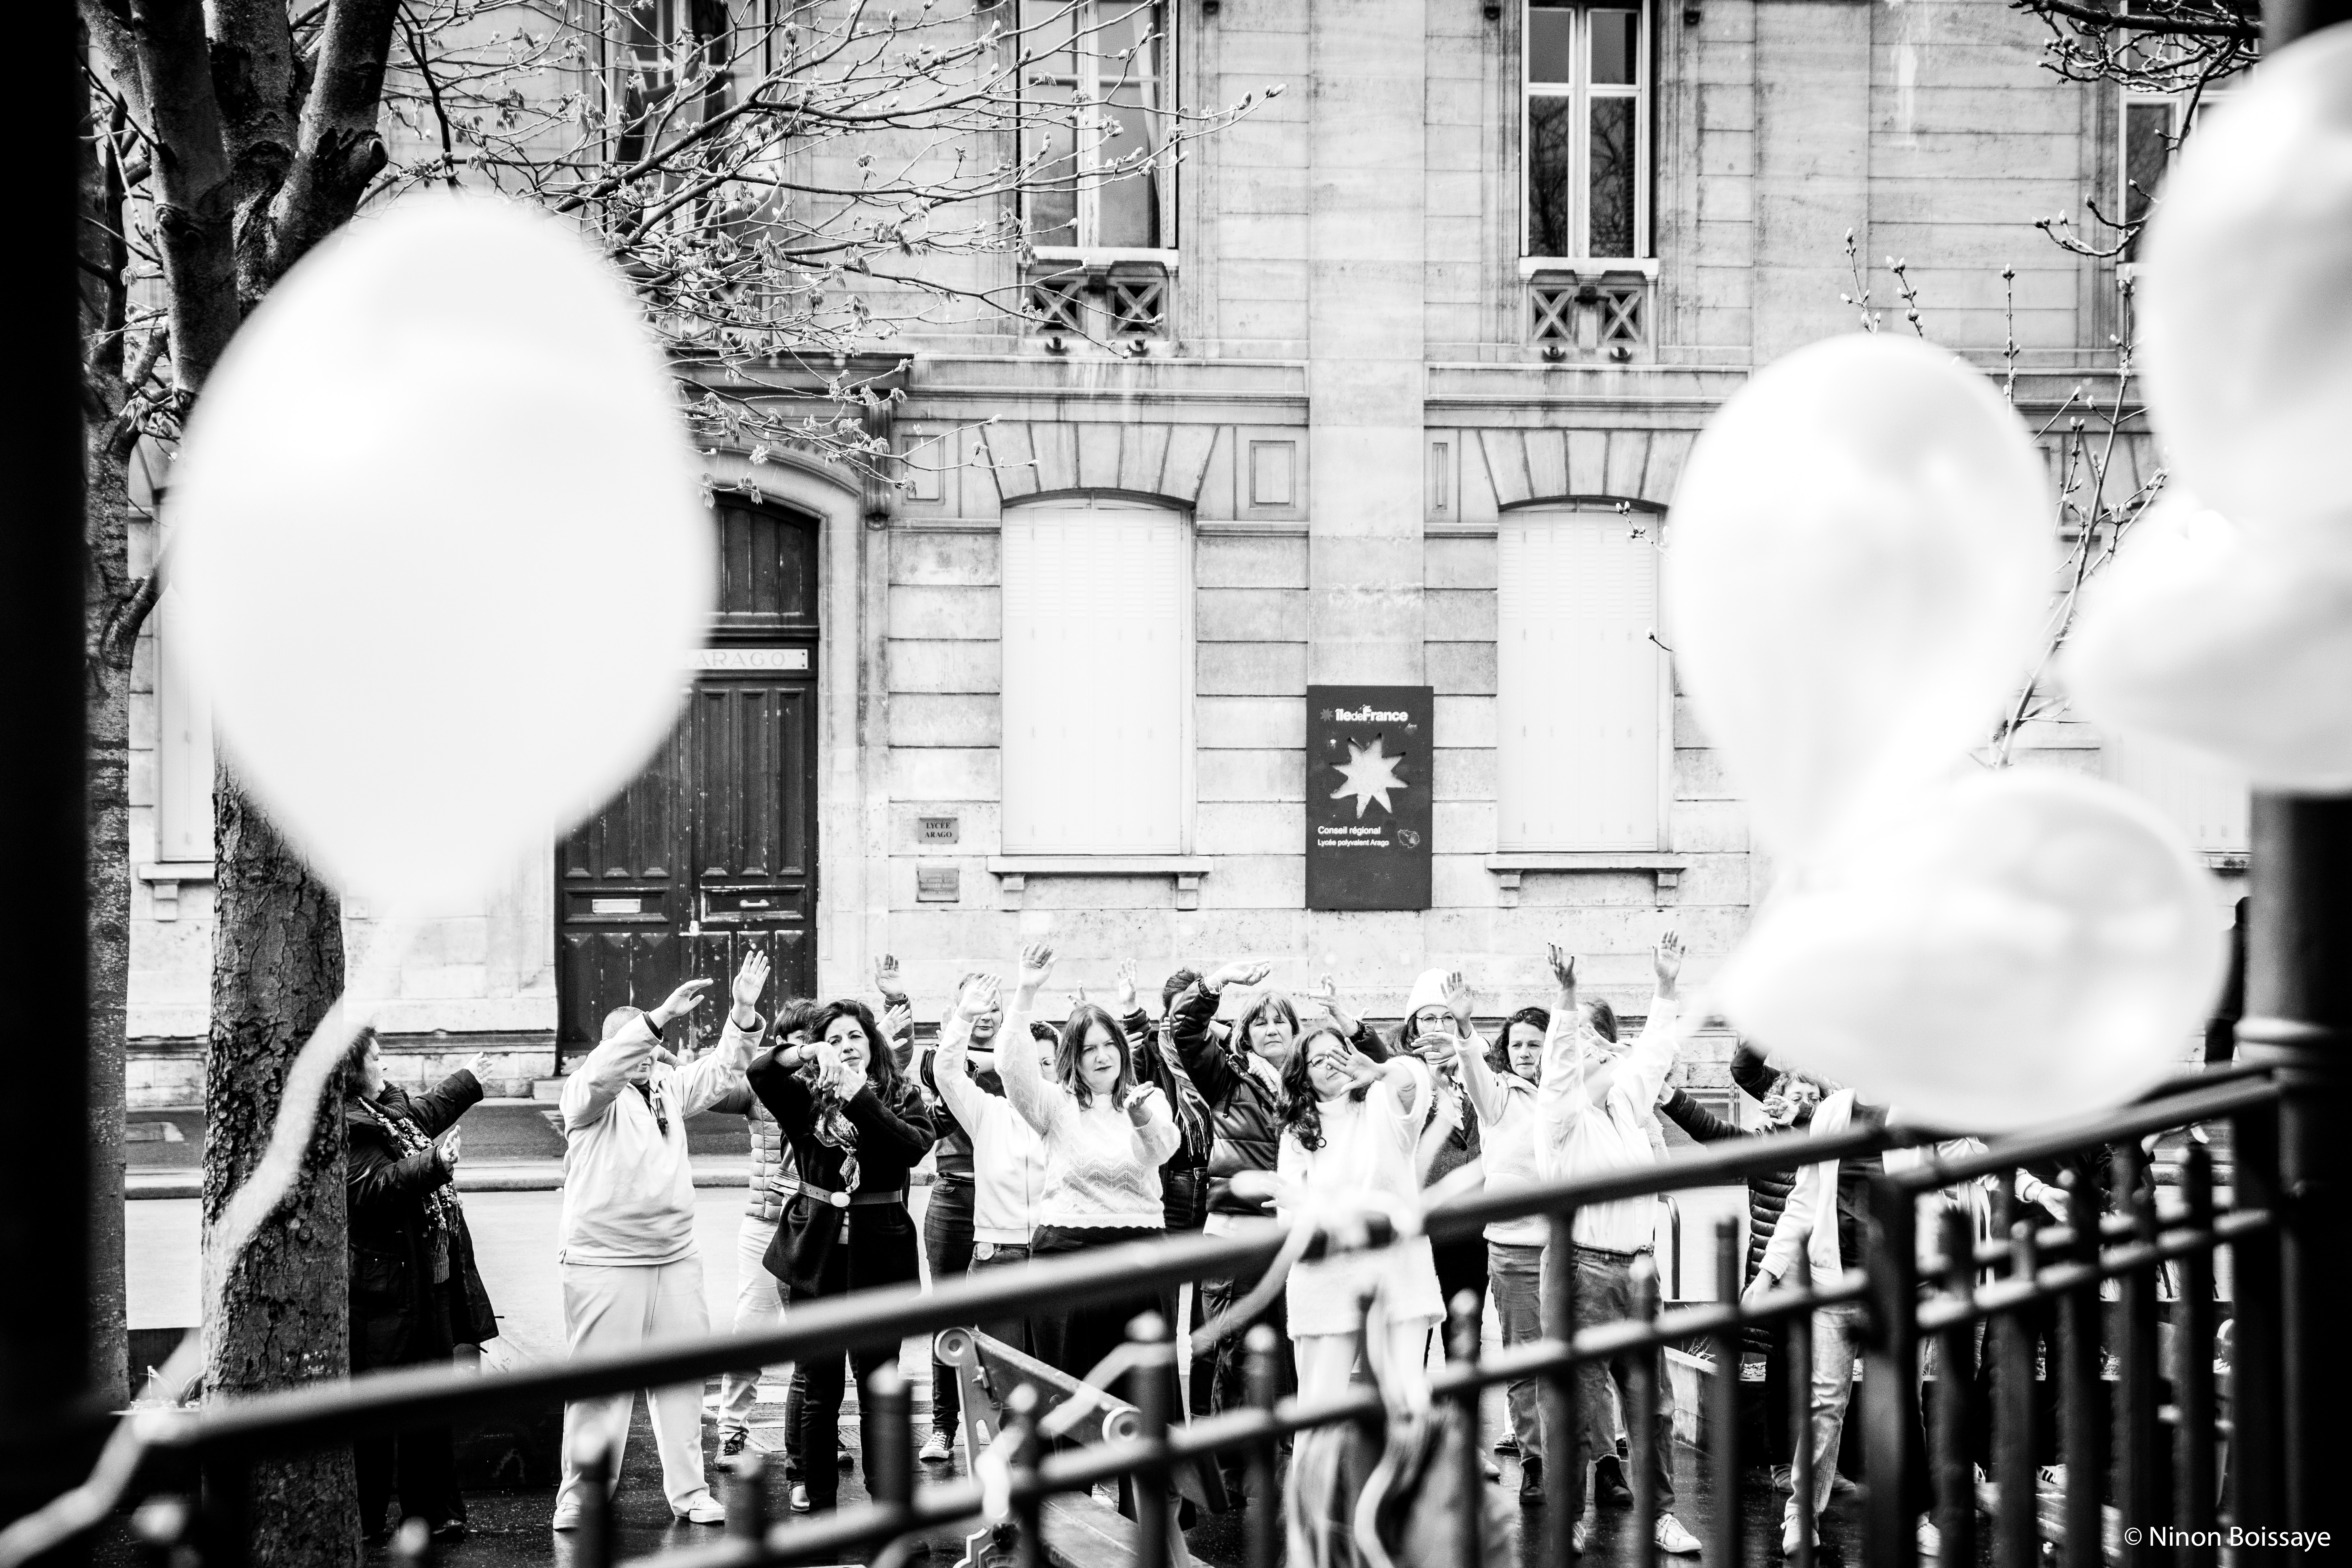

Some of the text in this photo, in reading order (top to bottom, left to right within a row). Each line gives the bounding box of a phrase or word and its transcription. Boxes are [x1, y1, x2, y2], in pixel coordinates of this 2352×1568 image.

[695, 652, 786, 667] ARAGO
[1317, 826, 1381, 836] Conseil régional
[1317, 839, 1390, 847] Lycée polyvalent Arago
